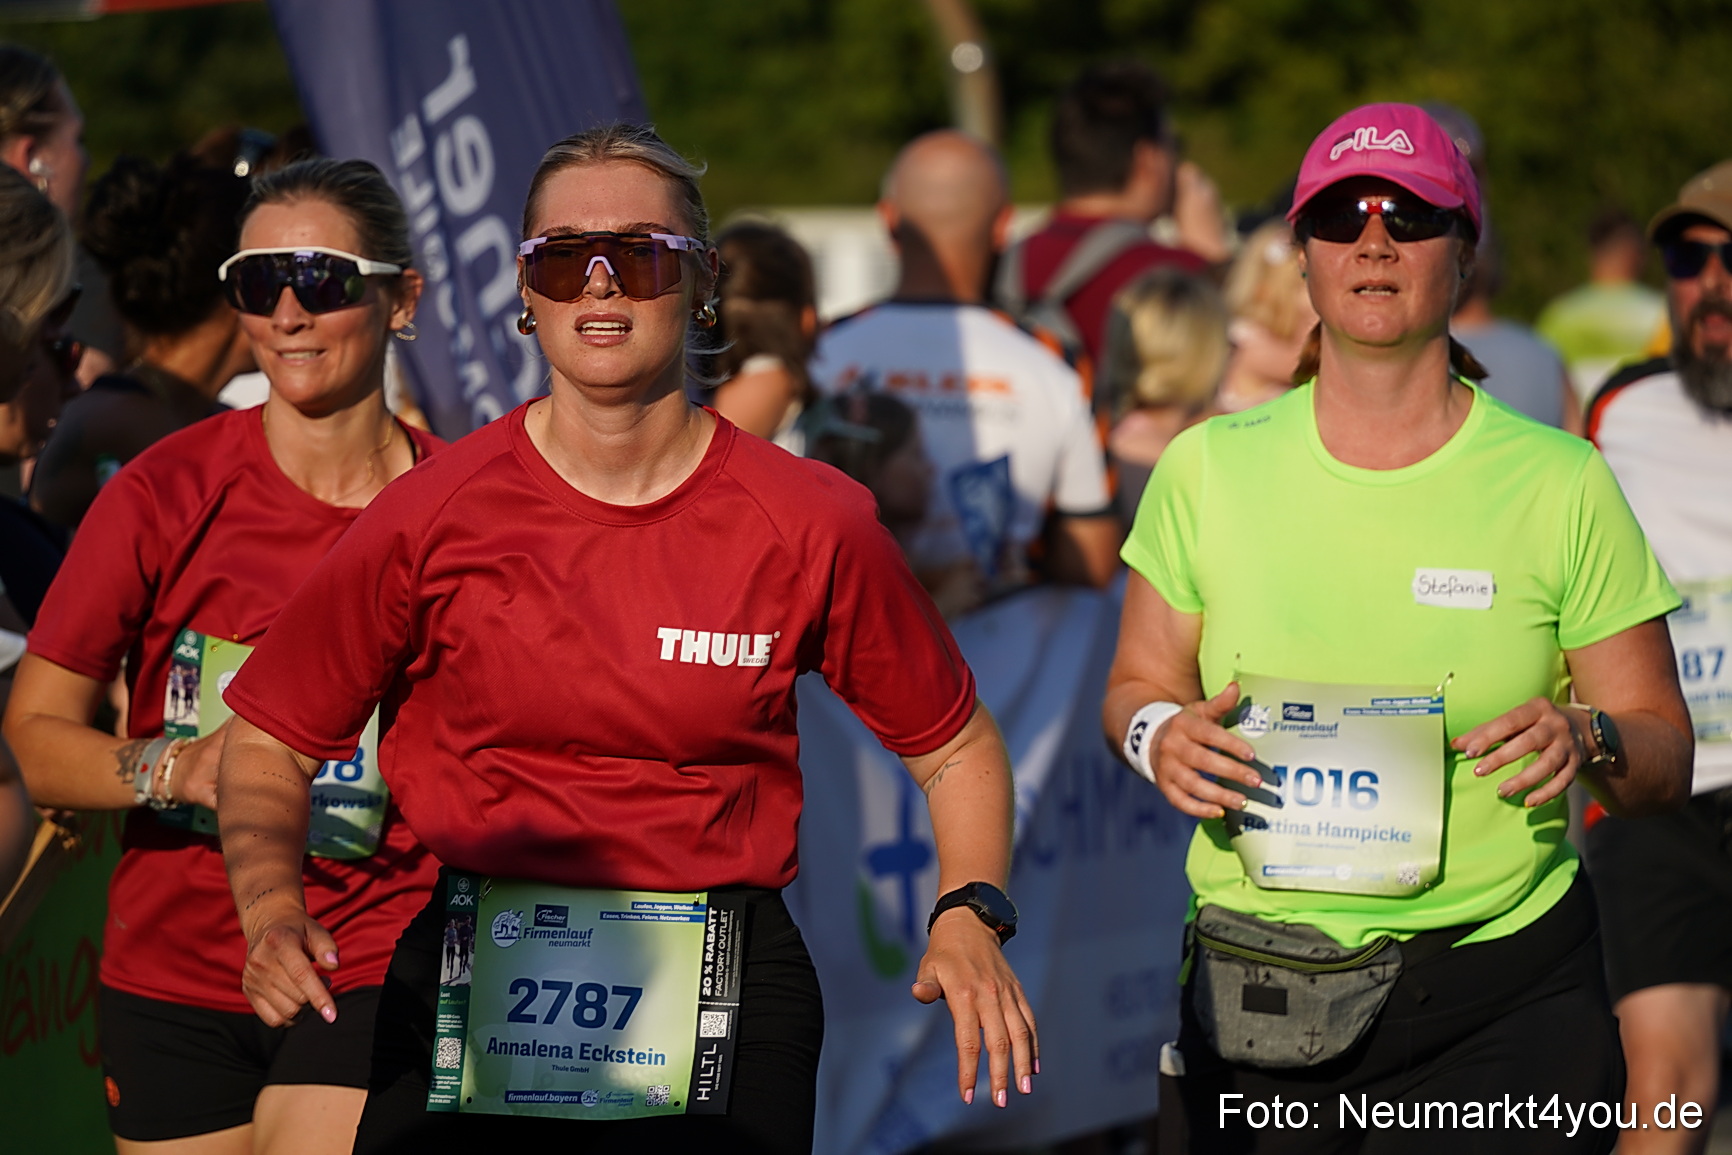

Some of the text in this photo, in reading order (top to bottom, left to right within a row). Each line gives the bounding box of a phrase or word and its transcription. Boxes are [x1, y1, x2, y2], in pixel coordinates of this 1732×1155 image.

[1329, 126, 1415, 161] FILA
[1418, 574, 1489, 598] Stefanie
[176, 644, 200, 660] AOK
[657, 626, 773, 667] THULE
[1273, 721, 1339, 732] Firmenlauf
[1273, 765, 1379, 810] 1016
[1243, 816, 1412, 843] Bettina Hampicke
[450, 894, 474, 906] AOK
[541, 912, 566, 921] Fischer
[523, 926, 594, 940] Firmenlauf
[548, 939, 590, 948] neumarkt
[705, 906, 717, 962] RABATT
[715, 909, 728, 997] FACTORY OUTLET
[702, 976, 712, 997] 20
[507, 977, 643, 1031] 2787
[487, 1037, 666, 1066] Annalena Eckstein
[552, 1064, 569, 1072] Thule
[696, 1043, 717, 1100] HILTL
[508, 1092, 578, 1103] firmenlauf.bayern
